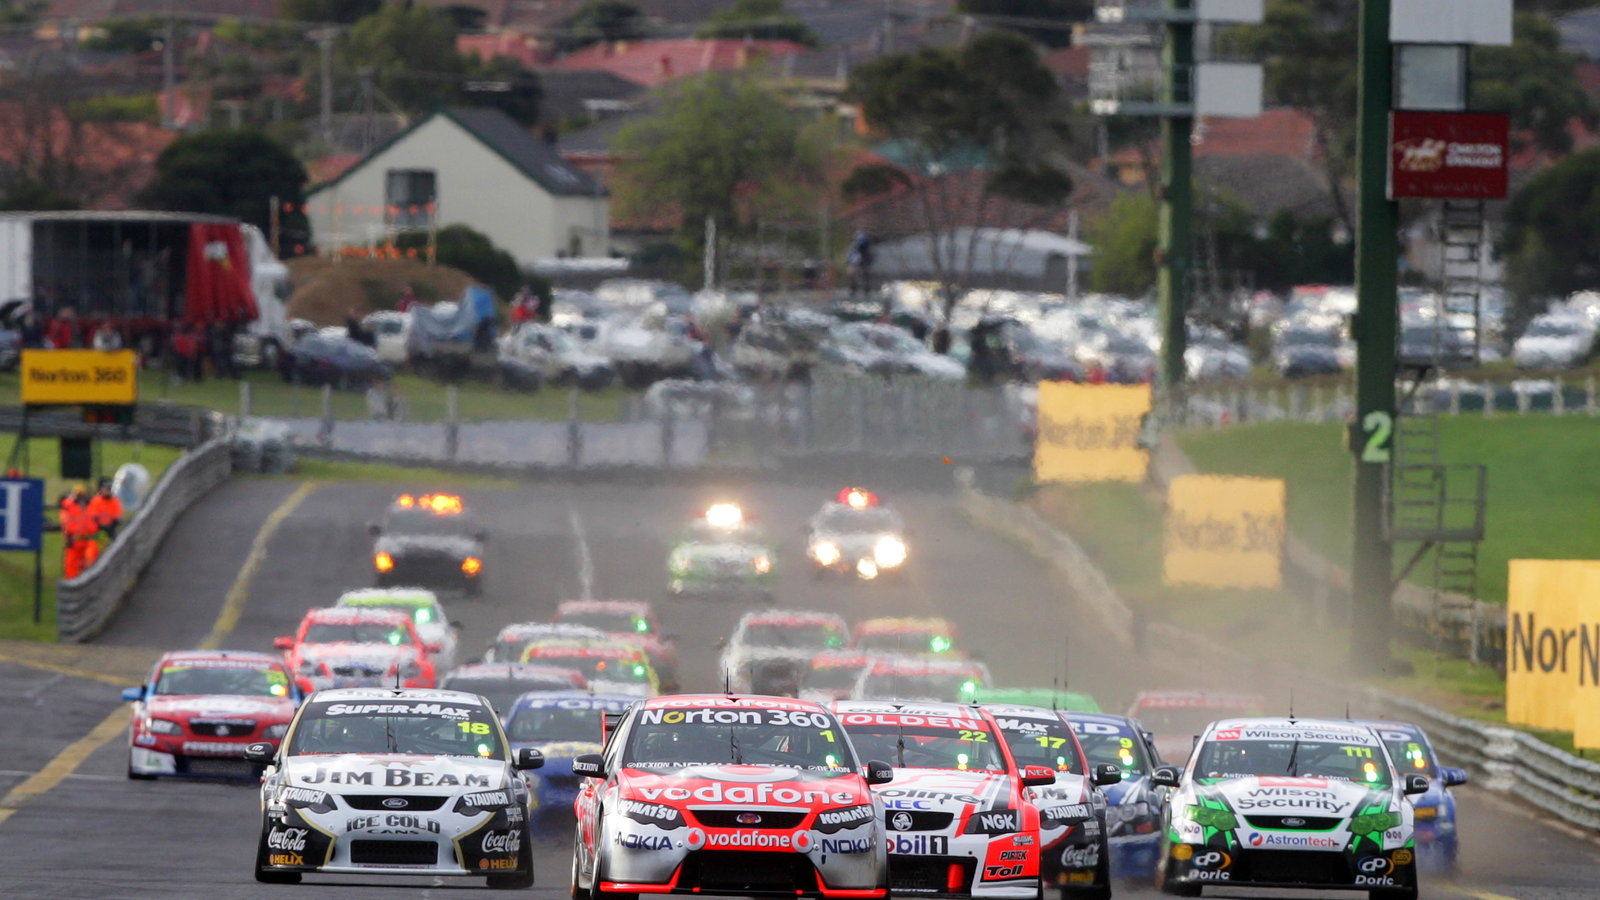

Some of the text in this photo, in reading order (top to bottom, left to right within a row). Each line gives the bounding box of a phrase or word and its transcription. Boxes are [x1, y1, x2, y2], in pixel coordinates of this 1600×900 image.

[28, 366, 126, 384] Norton 360
[1361, 410, 1393, 463] 2
[529, 700, 633, 711] FOR
[640, 709, 831, 729] Norton 360
[457, 721, 491, 735] 18
[820, 730, 835, 743] 1
[958, 729, 989, 743] 22
[1035, 736, 1067, 749] 17
[1245, 730, 1369, 744] Wilson Security
[1119, 737, 1134, 750] 9
[1344, 745, 1373, 759] 111
[301, 767, 490, 787] JIM BEAM
[463, 792, 508, 807] STAUNCH
[639, 782, 854, 805] vodafone
[871, 789, 980, 804] oline
[1247, 788, 1337, 800] Wilson
[1045, 804, 1089, 819] STAUNCH
[346, 814, 440, 834] ICE COLD
[981, 814, 1015, 830] NGK
[615, 831, 673, 851] NOKIA
[708, 831, 790, 847] vodafone
[886, 834, 927, 855] obil
[1266, 834, 1335, 848] Astrontech
[274, 851, 304, 865] HELIX
[986, 864, 1023, 877] Toll
[1188, 869, 1230, 880] Doric
[1355, 874, 1394, 886] Doric
